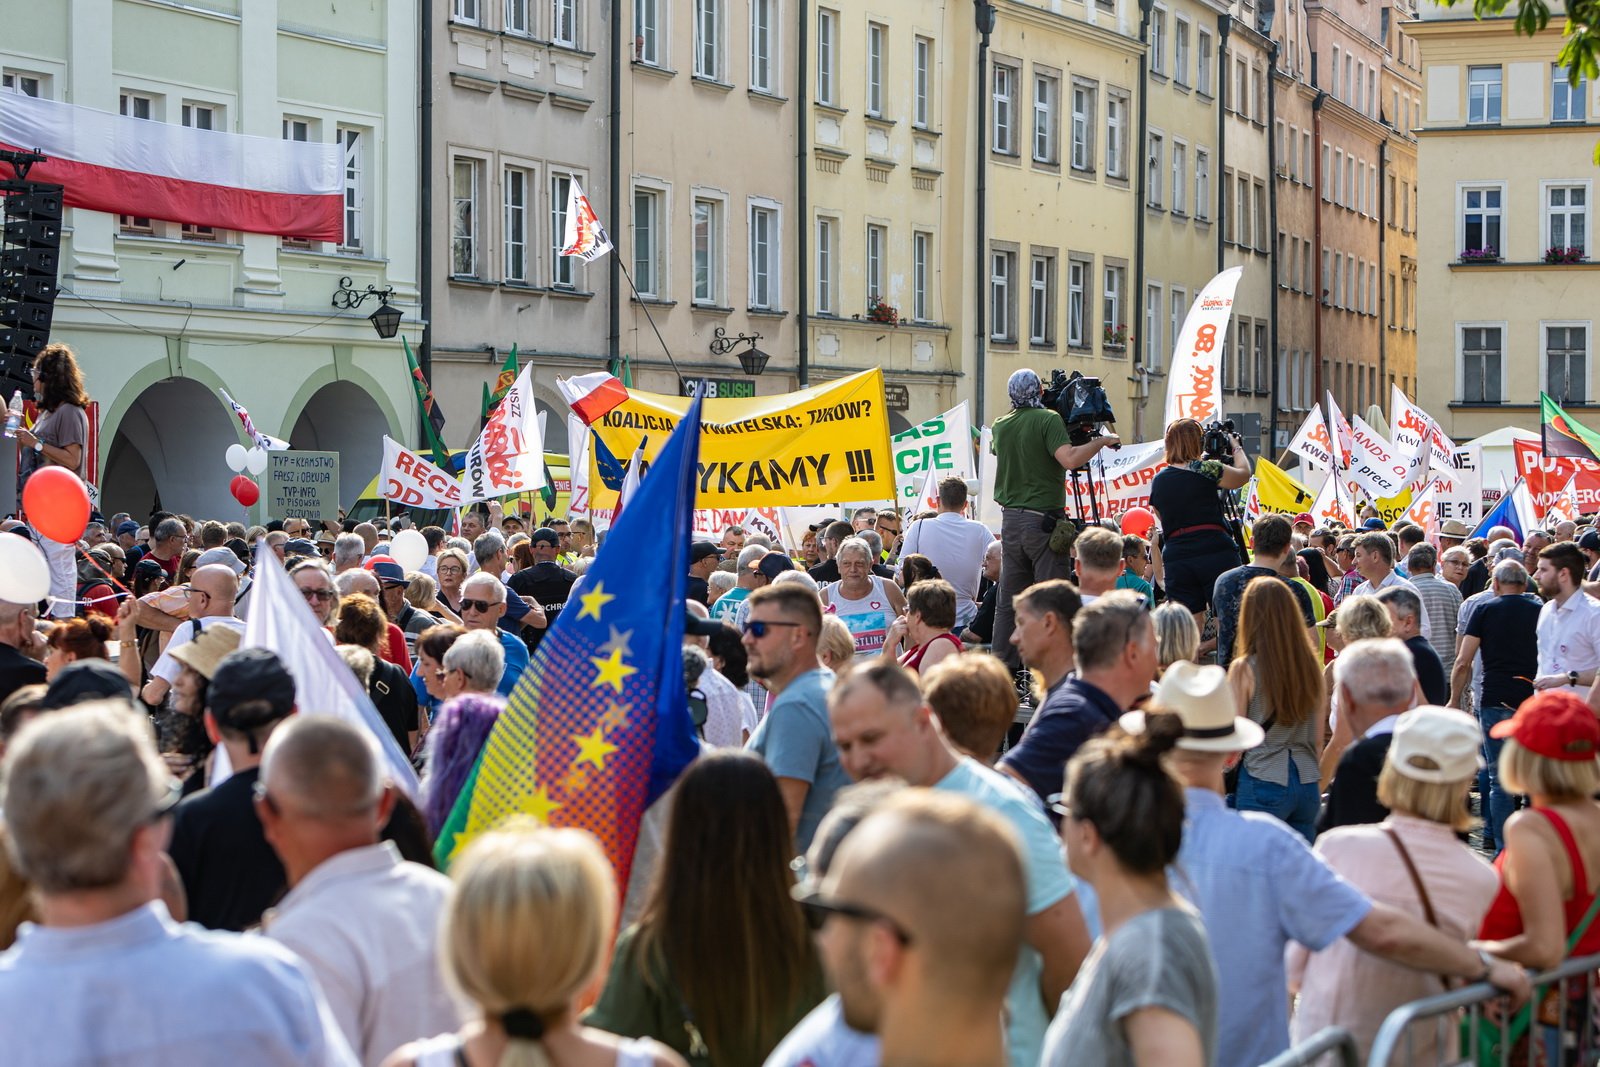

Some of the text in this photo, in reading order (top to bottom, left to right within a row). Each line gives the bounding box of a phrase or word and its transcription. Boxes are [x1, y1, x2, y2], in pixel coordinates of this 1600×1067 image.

[719, 382, 754, 398] SUSHI
[509, 387, 522, 418] NSZZ
[602, 410, 676, 433] KOALICJA
[699, 414, 803, 434] YWATELSKA:
[272, 456, 289, 467] TVP
[1301, 441, 1330, 463] KWB
[1522, 450, 1563, 476] PO,
[395, 451, 461, 501] RĘCE
[1358, 465, 1393, 490] precz
[276, 497, 285, 507] TO
[1458, 502, 1472, 518] ?!
